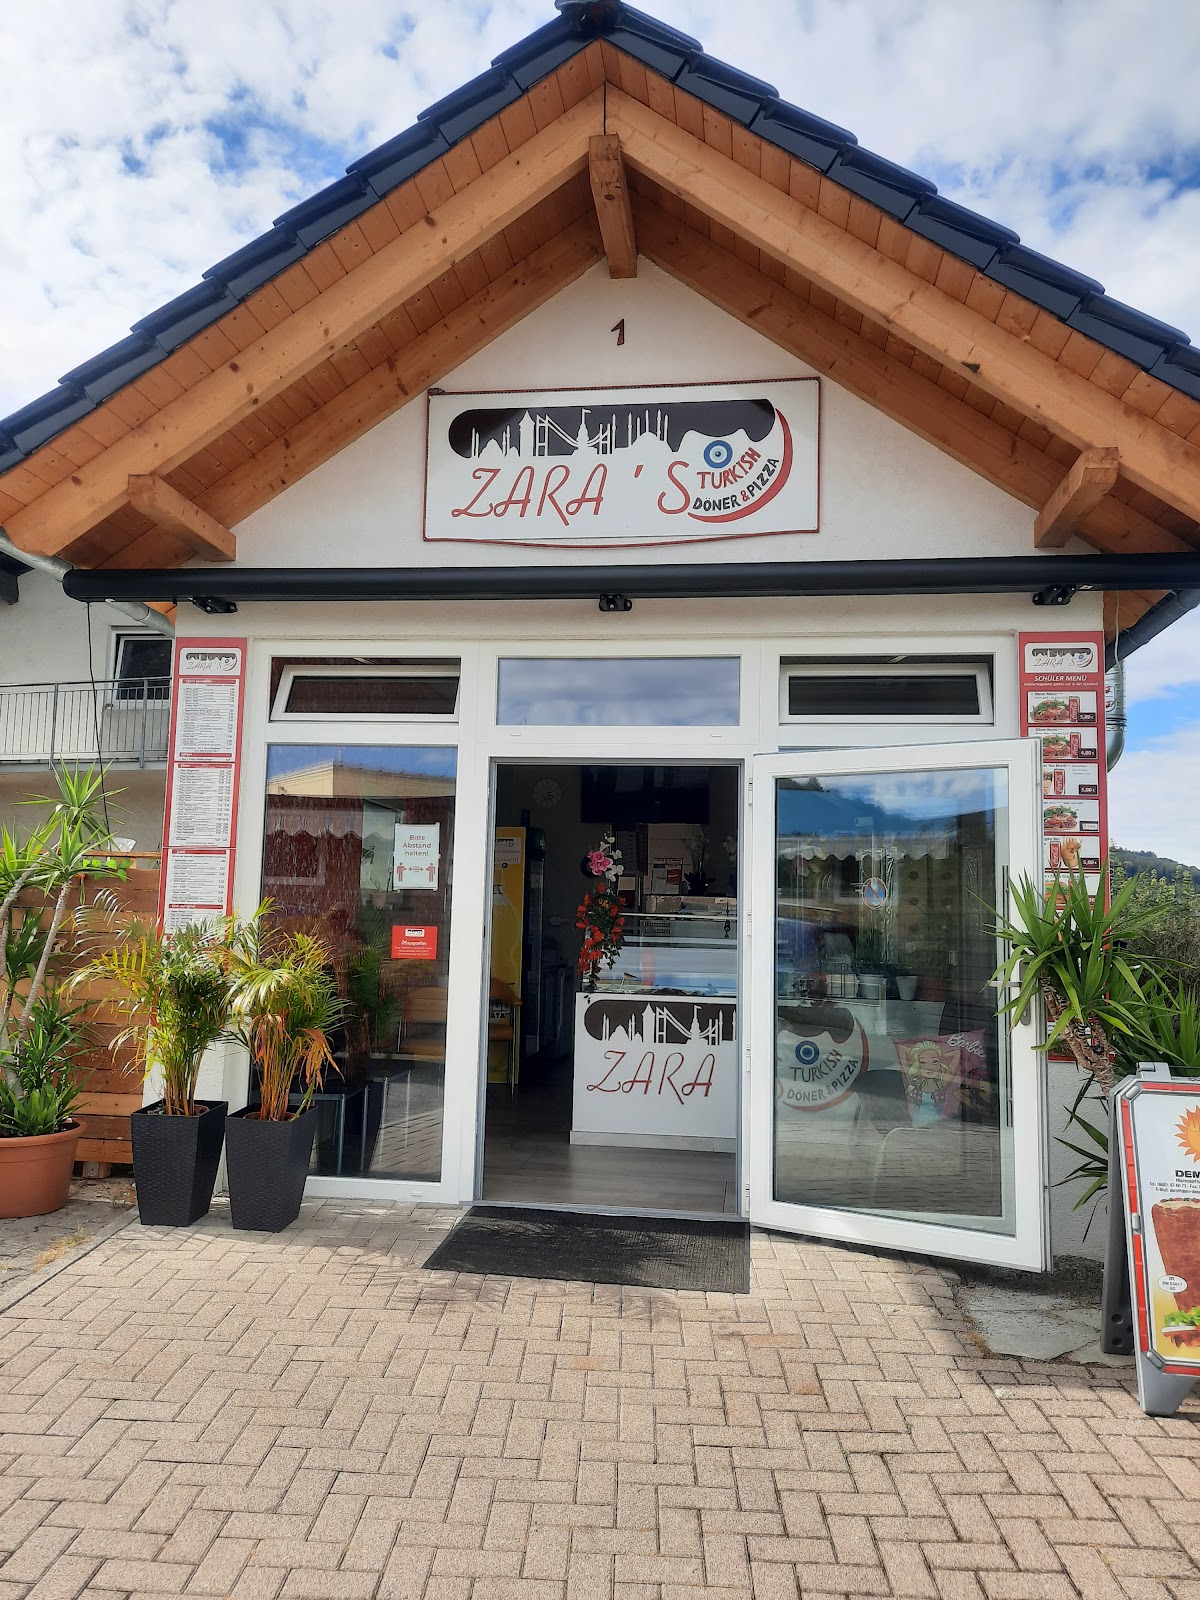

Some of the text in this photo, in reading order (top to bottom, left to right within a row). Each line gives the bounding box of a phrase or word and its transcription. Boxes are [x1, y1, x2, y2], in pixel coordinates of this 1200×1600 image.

[611, 318, 625, 346] 1
[696, 447, 762, 490] TURKISH
[692, 494, 741, 512] DÖNER
[746, 458, 780, 498] PIZZA
[1034, 674, 1087, 682] SCHÜLER MENÜ
[946, 1032, 986, 1058] Barbie
[586, 1050, 716, 1105] ZARA
[789, 1048, 842, 1083] TURKISH
[786, 1088, 827, 1102] DÖNER
